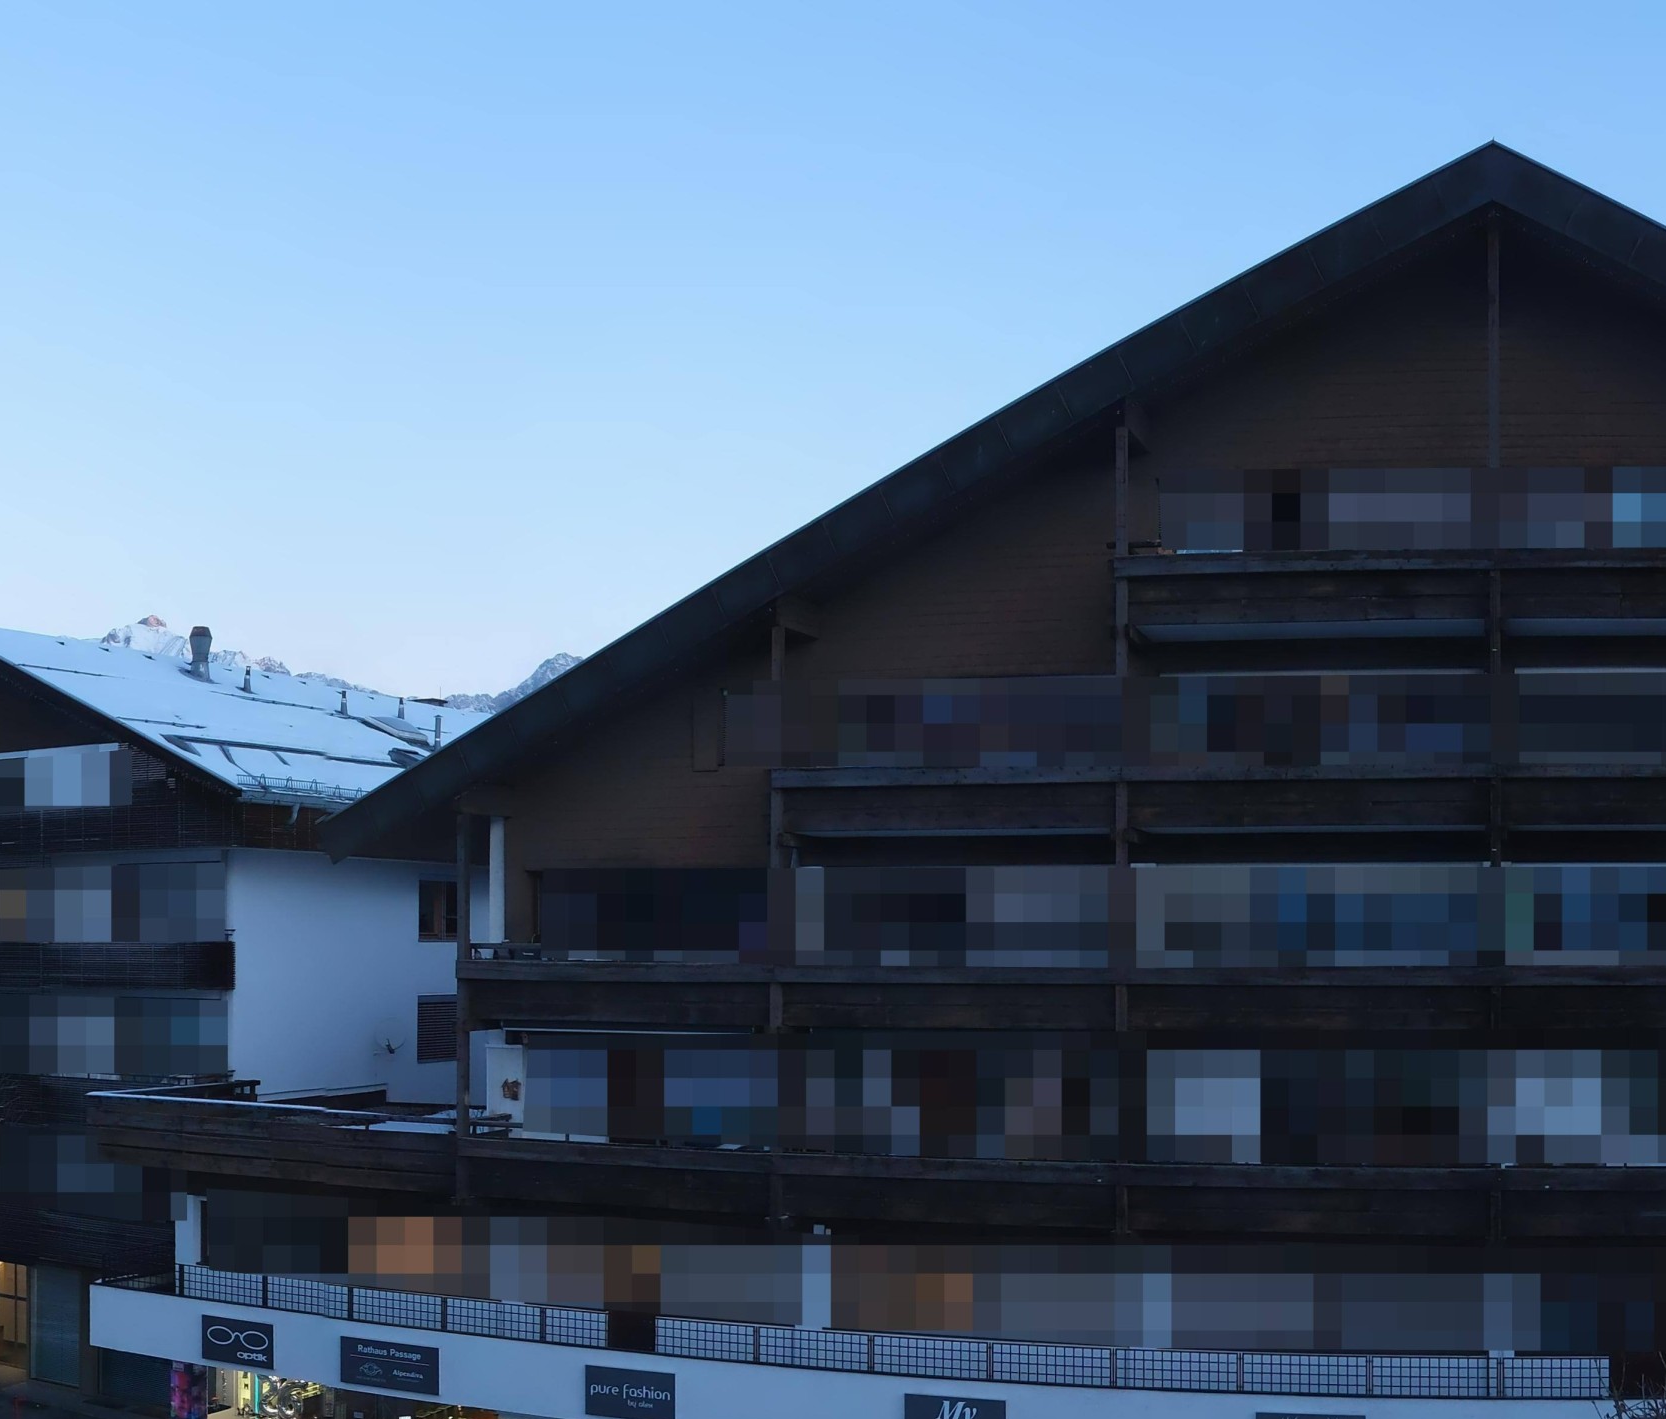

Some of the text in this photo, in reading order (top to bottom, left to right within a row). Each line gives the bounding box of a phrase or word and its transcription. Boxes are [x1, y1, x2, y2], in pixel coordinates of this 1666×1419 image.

[237, 1351, 268, 1362] optik
[357, 1344, 421, 1361] Rathaus Passage
[590, 1384, 671, 1401] pure fashion
